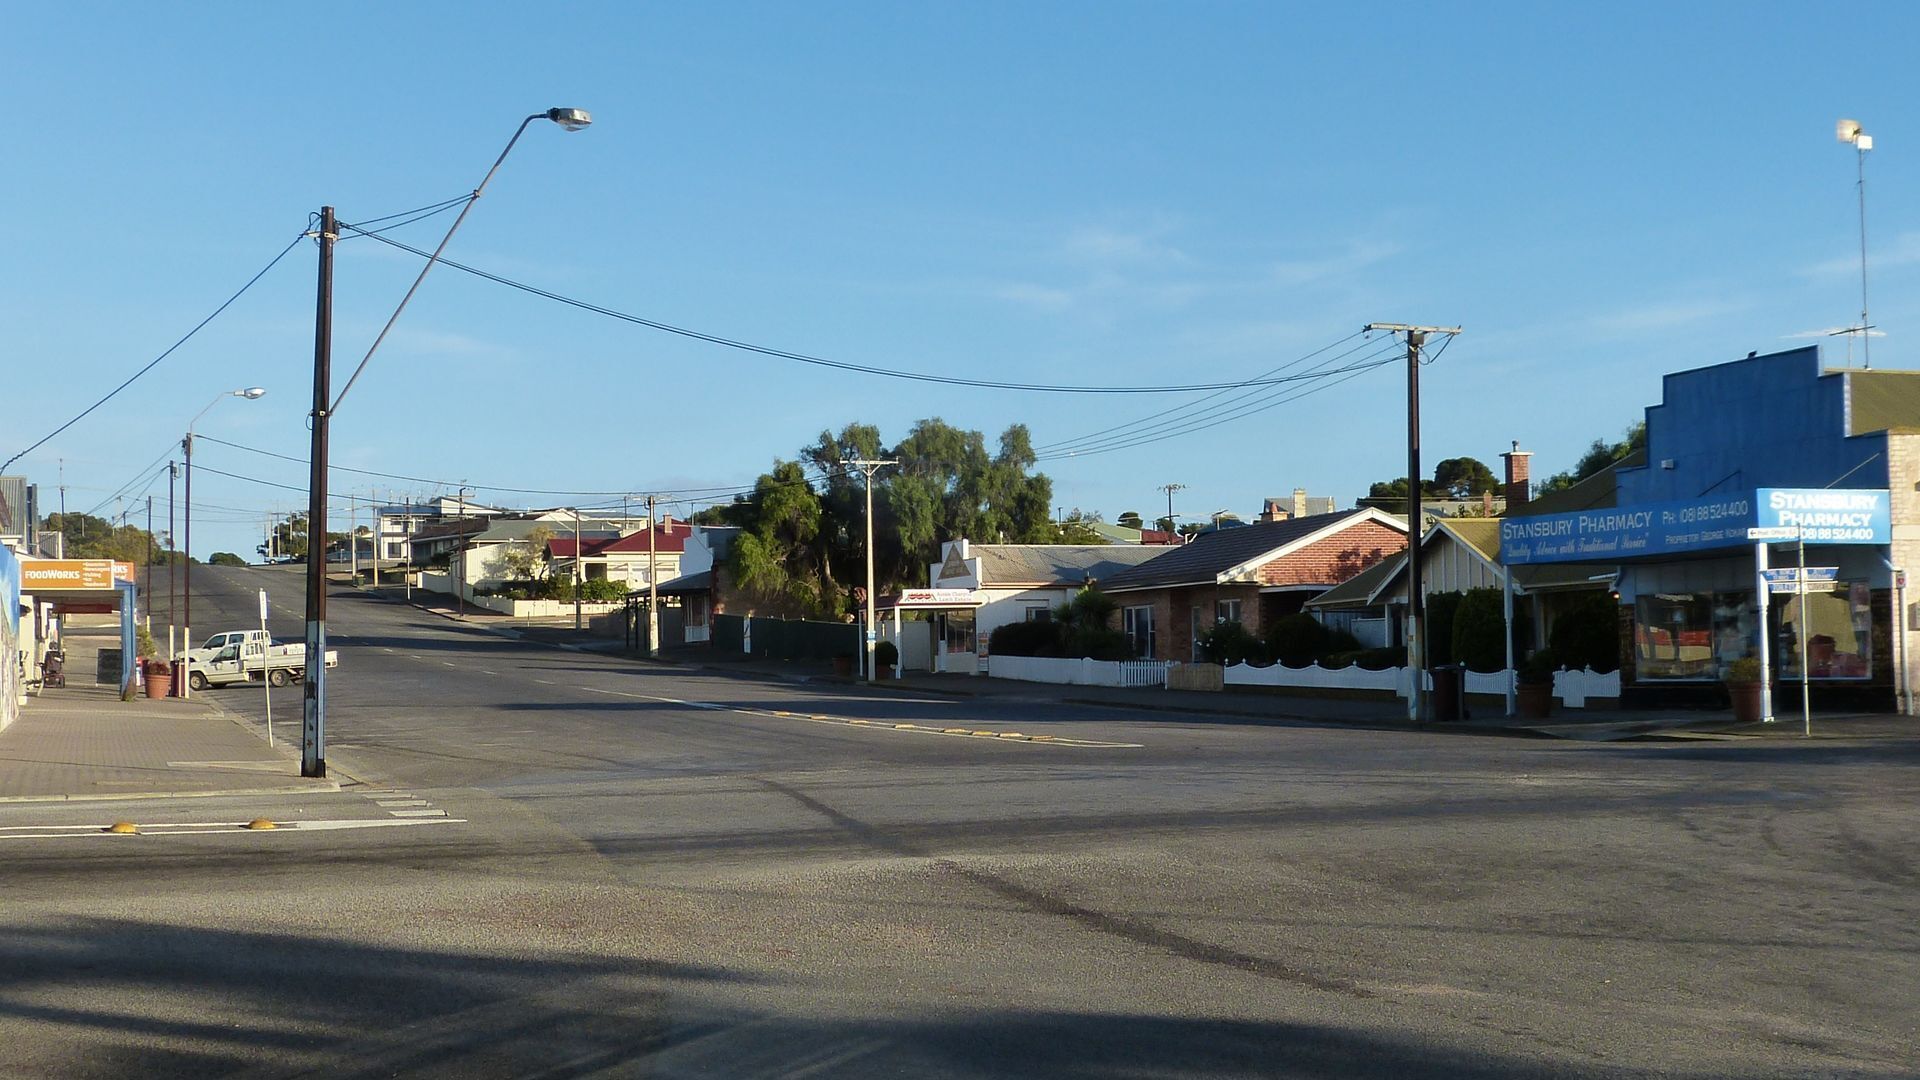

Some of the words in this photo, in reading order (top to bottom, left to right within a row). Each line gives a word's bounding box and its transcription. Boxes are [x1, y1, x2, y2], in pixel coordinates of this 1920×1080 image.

[1770, 491, 1879, 510] STANSBURY
[1503, 519, 1573, 540] STANSBURY
[1579, 511, 1653, 534] PHARMACY
[1779, 510, 1872, 527] PHARMACY
[25, 570, 80, 580] FOODWORKS
